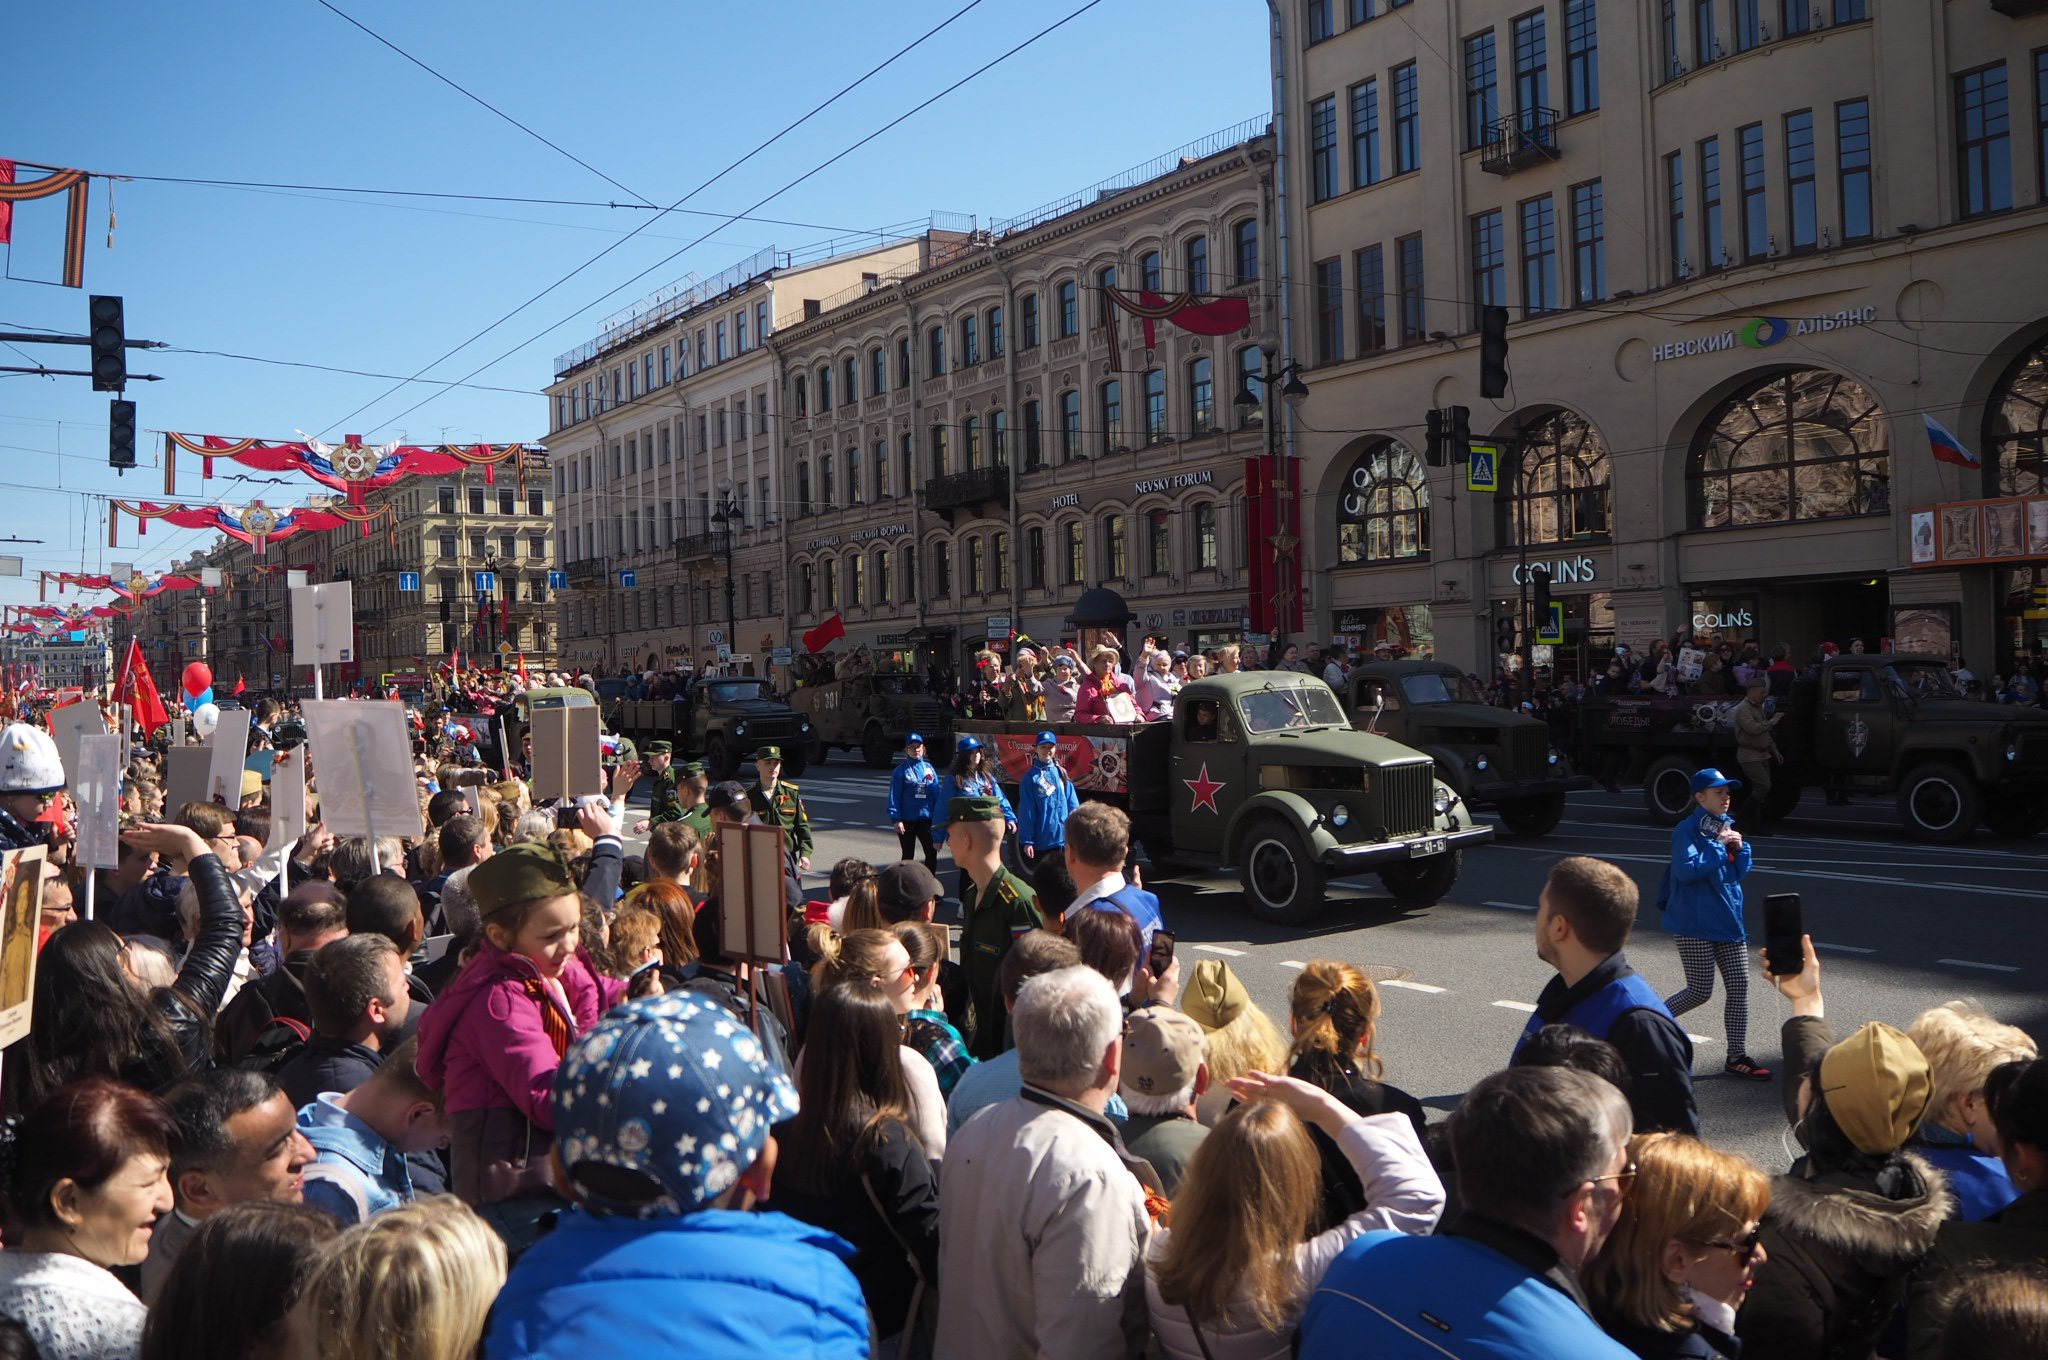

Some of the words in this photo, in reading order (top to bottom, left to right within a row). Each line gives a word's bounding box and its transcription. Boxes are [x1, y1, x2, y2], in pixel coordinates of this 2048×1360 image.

[1651, 330, 1735, 362] НЕВСКИЙ
[1795, 305, 1877, 336] АЛЬЯНС
[1052, 493, 1079, 509] HOTEL
[1135, 477, 1170, 495] NEVSKY
[1174, 470, 1213, 488] FORUM
[850, 527, 879, 542] НЕВСКИЙ
[880, 523, 906, 537] ФОРУМ
[1512, 555, 1597, 586] COLIN'S
[1340, 623, 1367, 633] SUMMER
[1692, 607, 1753, 629] COLIN'S
[824, 690, 839, 710] 301
